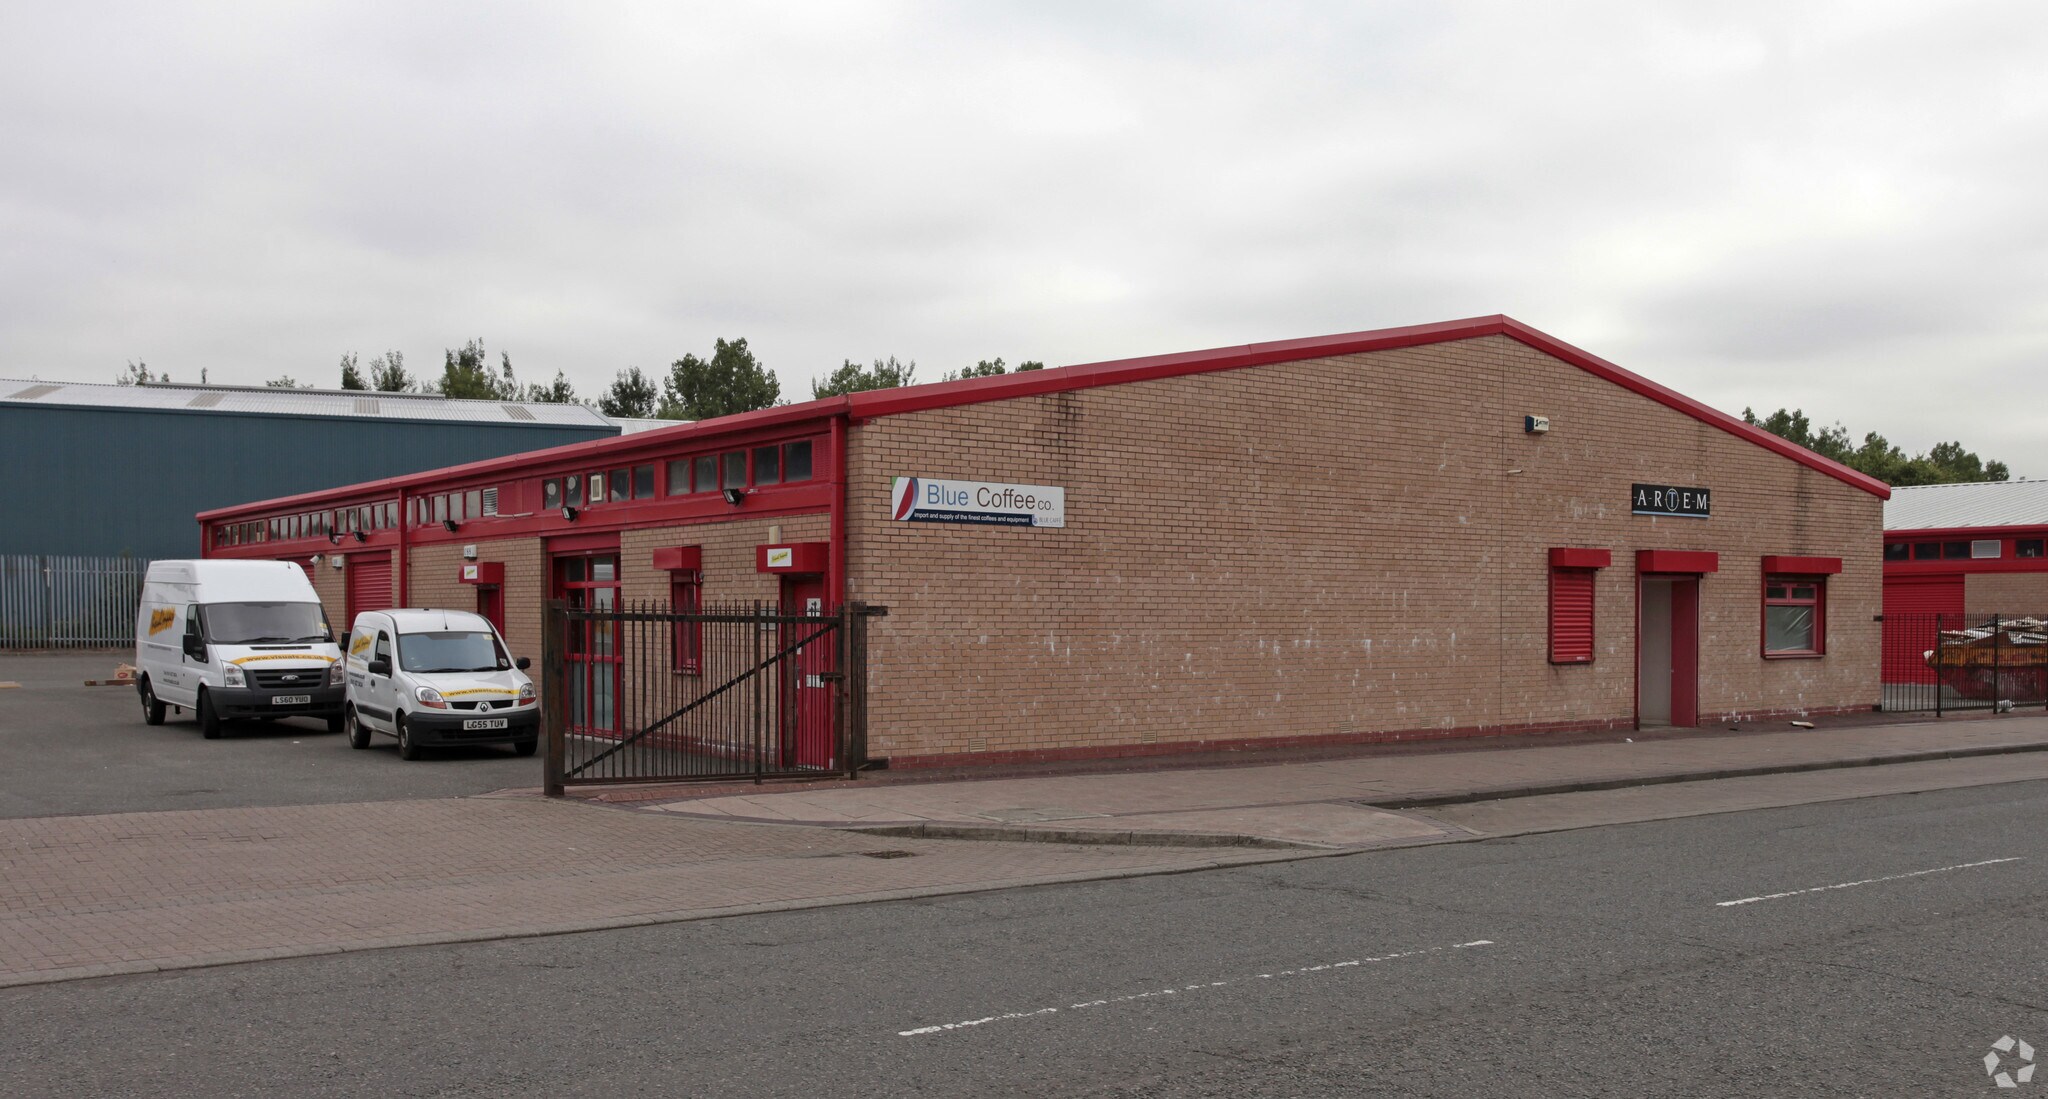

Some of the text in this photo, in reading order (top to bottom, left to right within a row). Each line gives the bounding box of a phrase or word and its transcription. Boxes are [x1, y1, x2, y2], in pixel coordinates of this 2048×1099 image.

[927, 484, 1054, 511] Blue Coffee co.
[274, 696, 293, 704] LS60
